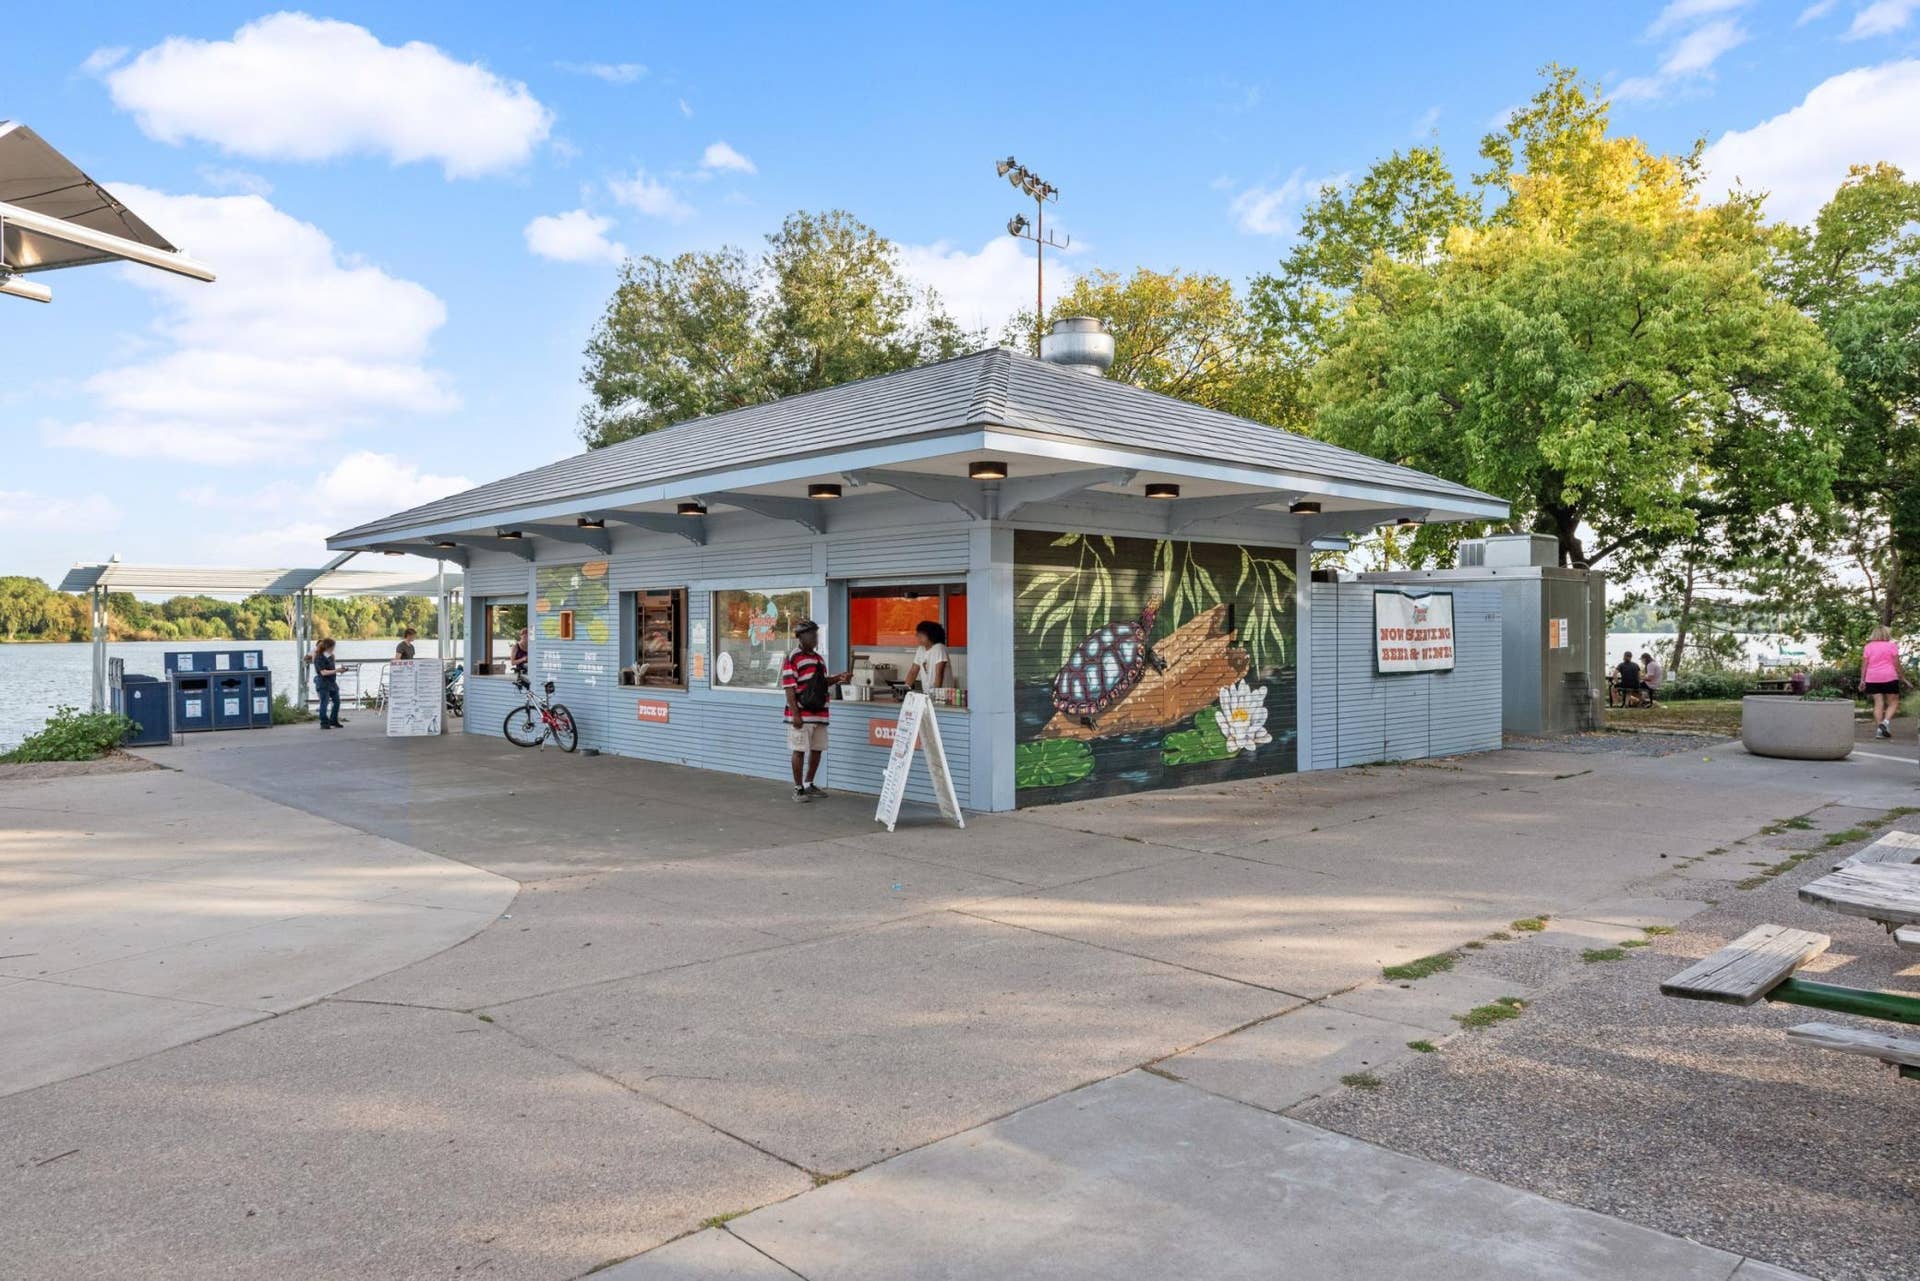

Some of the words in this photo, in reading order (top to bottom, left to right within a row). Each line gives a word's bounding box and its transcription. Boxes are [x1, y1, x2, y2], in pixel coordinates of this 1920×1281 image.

[1380, 628, 1404, 641] NOW
[1410, 647, 1419, 660] &
[639, 704, 657, 716] PICK
[657, 706, 668, 717] UP
